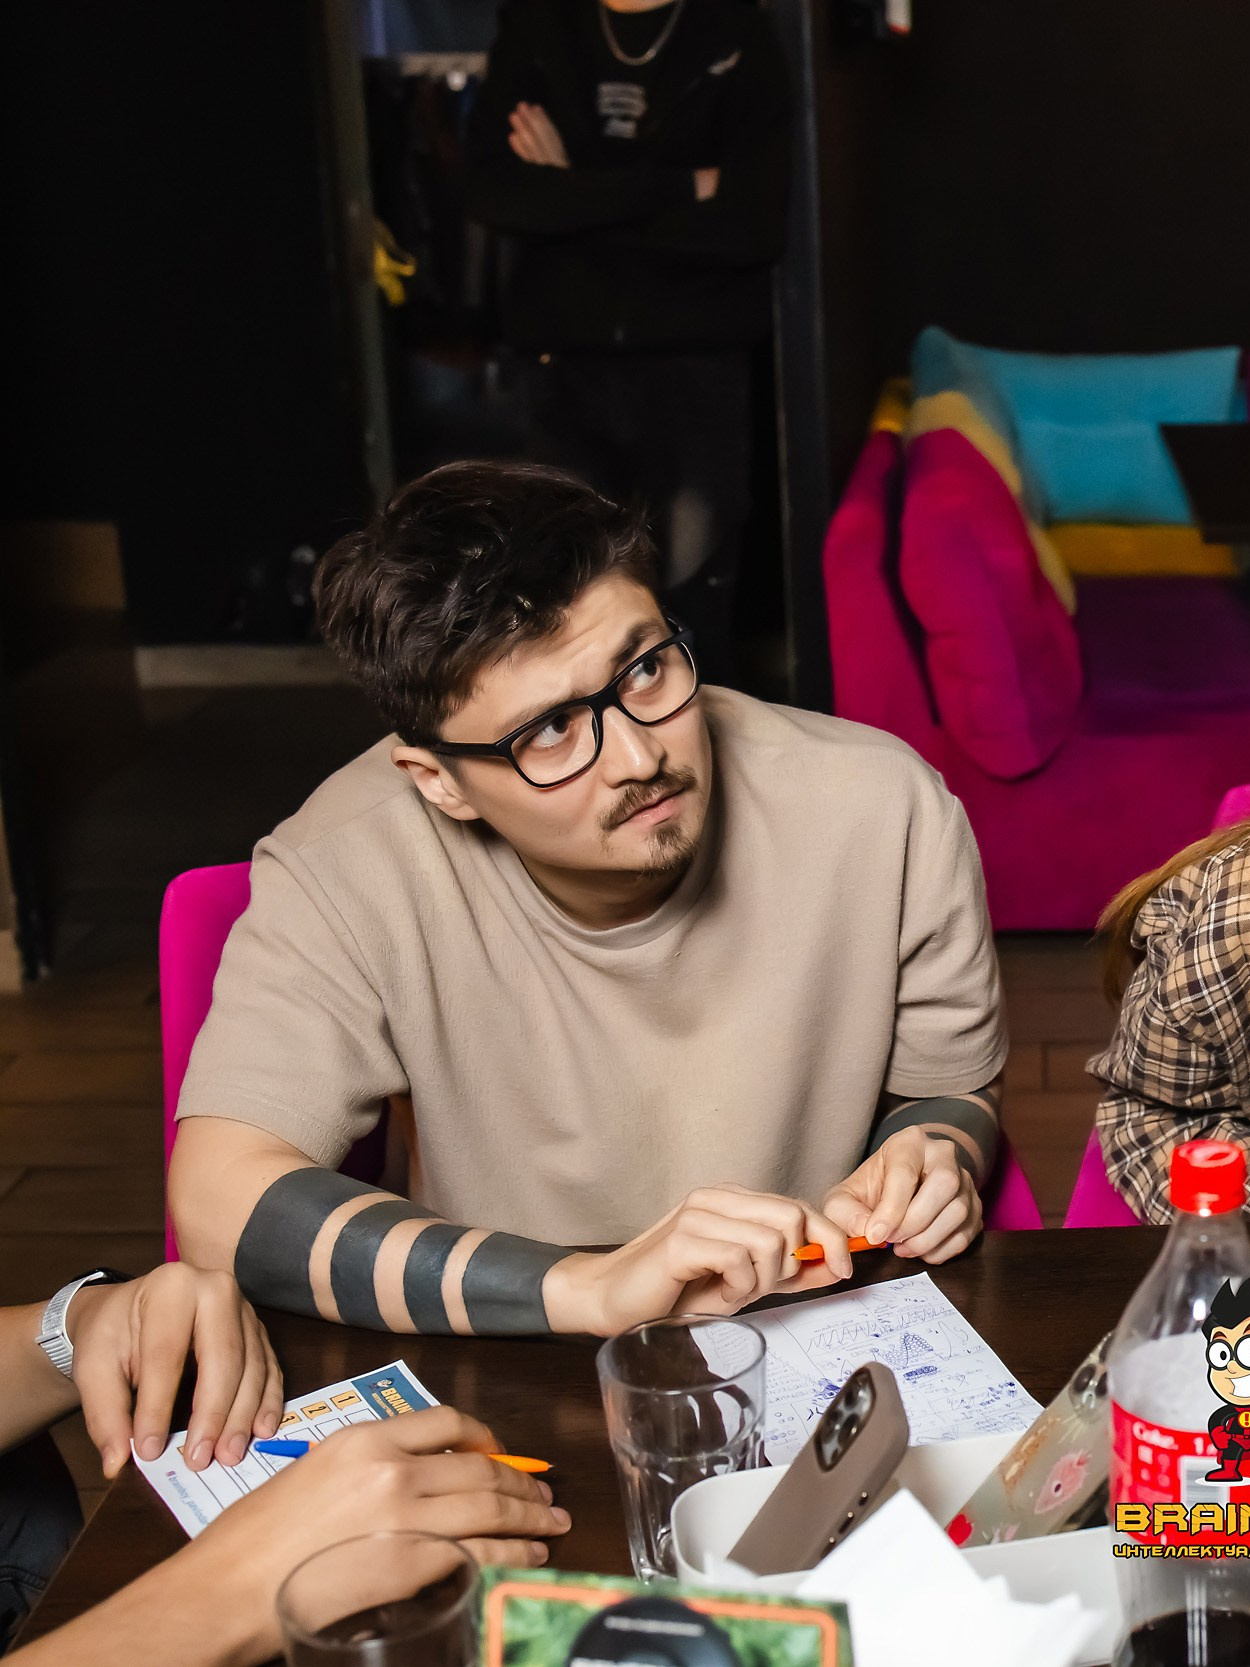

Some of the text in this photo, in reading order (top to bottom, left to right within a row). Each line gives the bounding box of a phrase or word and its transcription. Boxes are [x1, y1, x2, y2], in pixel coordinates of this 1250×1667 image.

[337, 1395, 356, 1404] 1
[380, 1387, 415, 1415] BRAIN
[308, 1405, 327, 1414] 2
